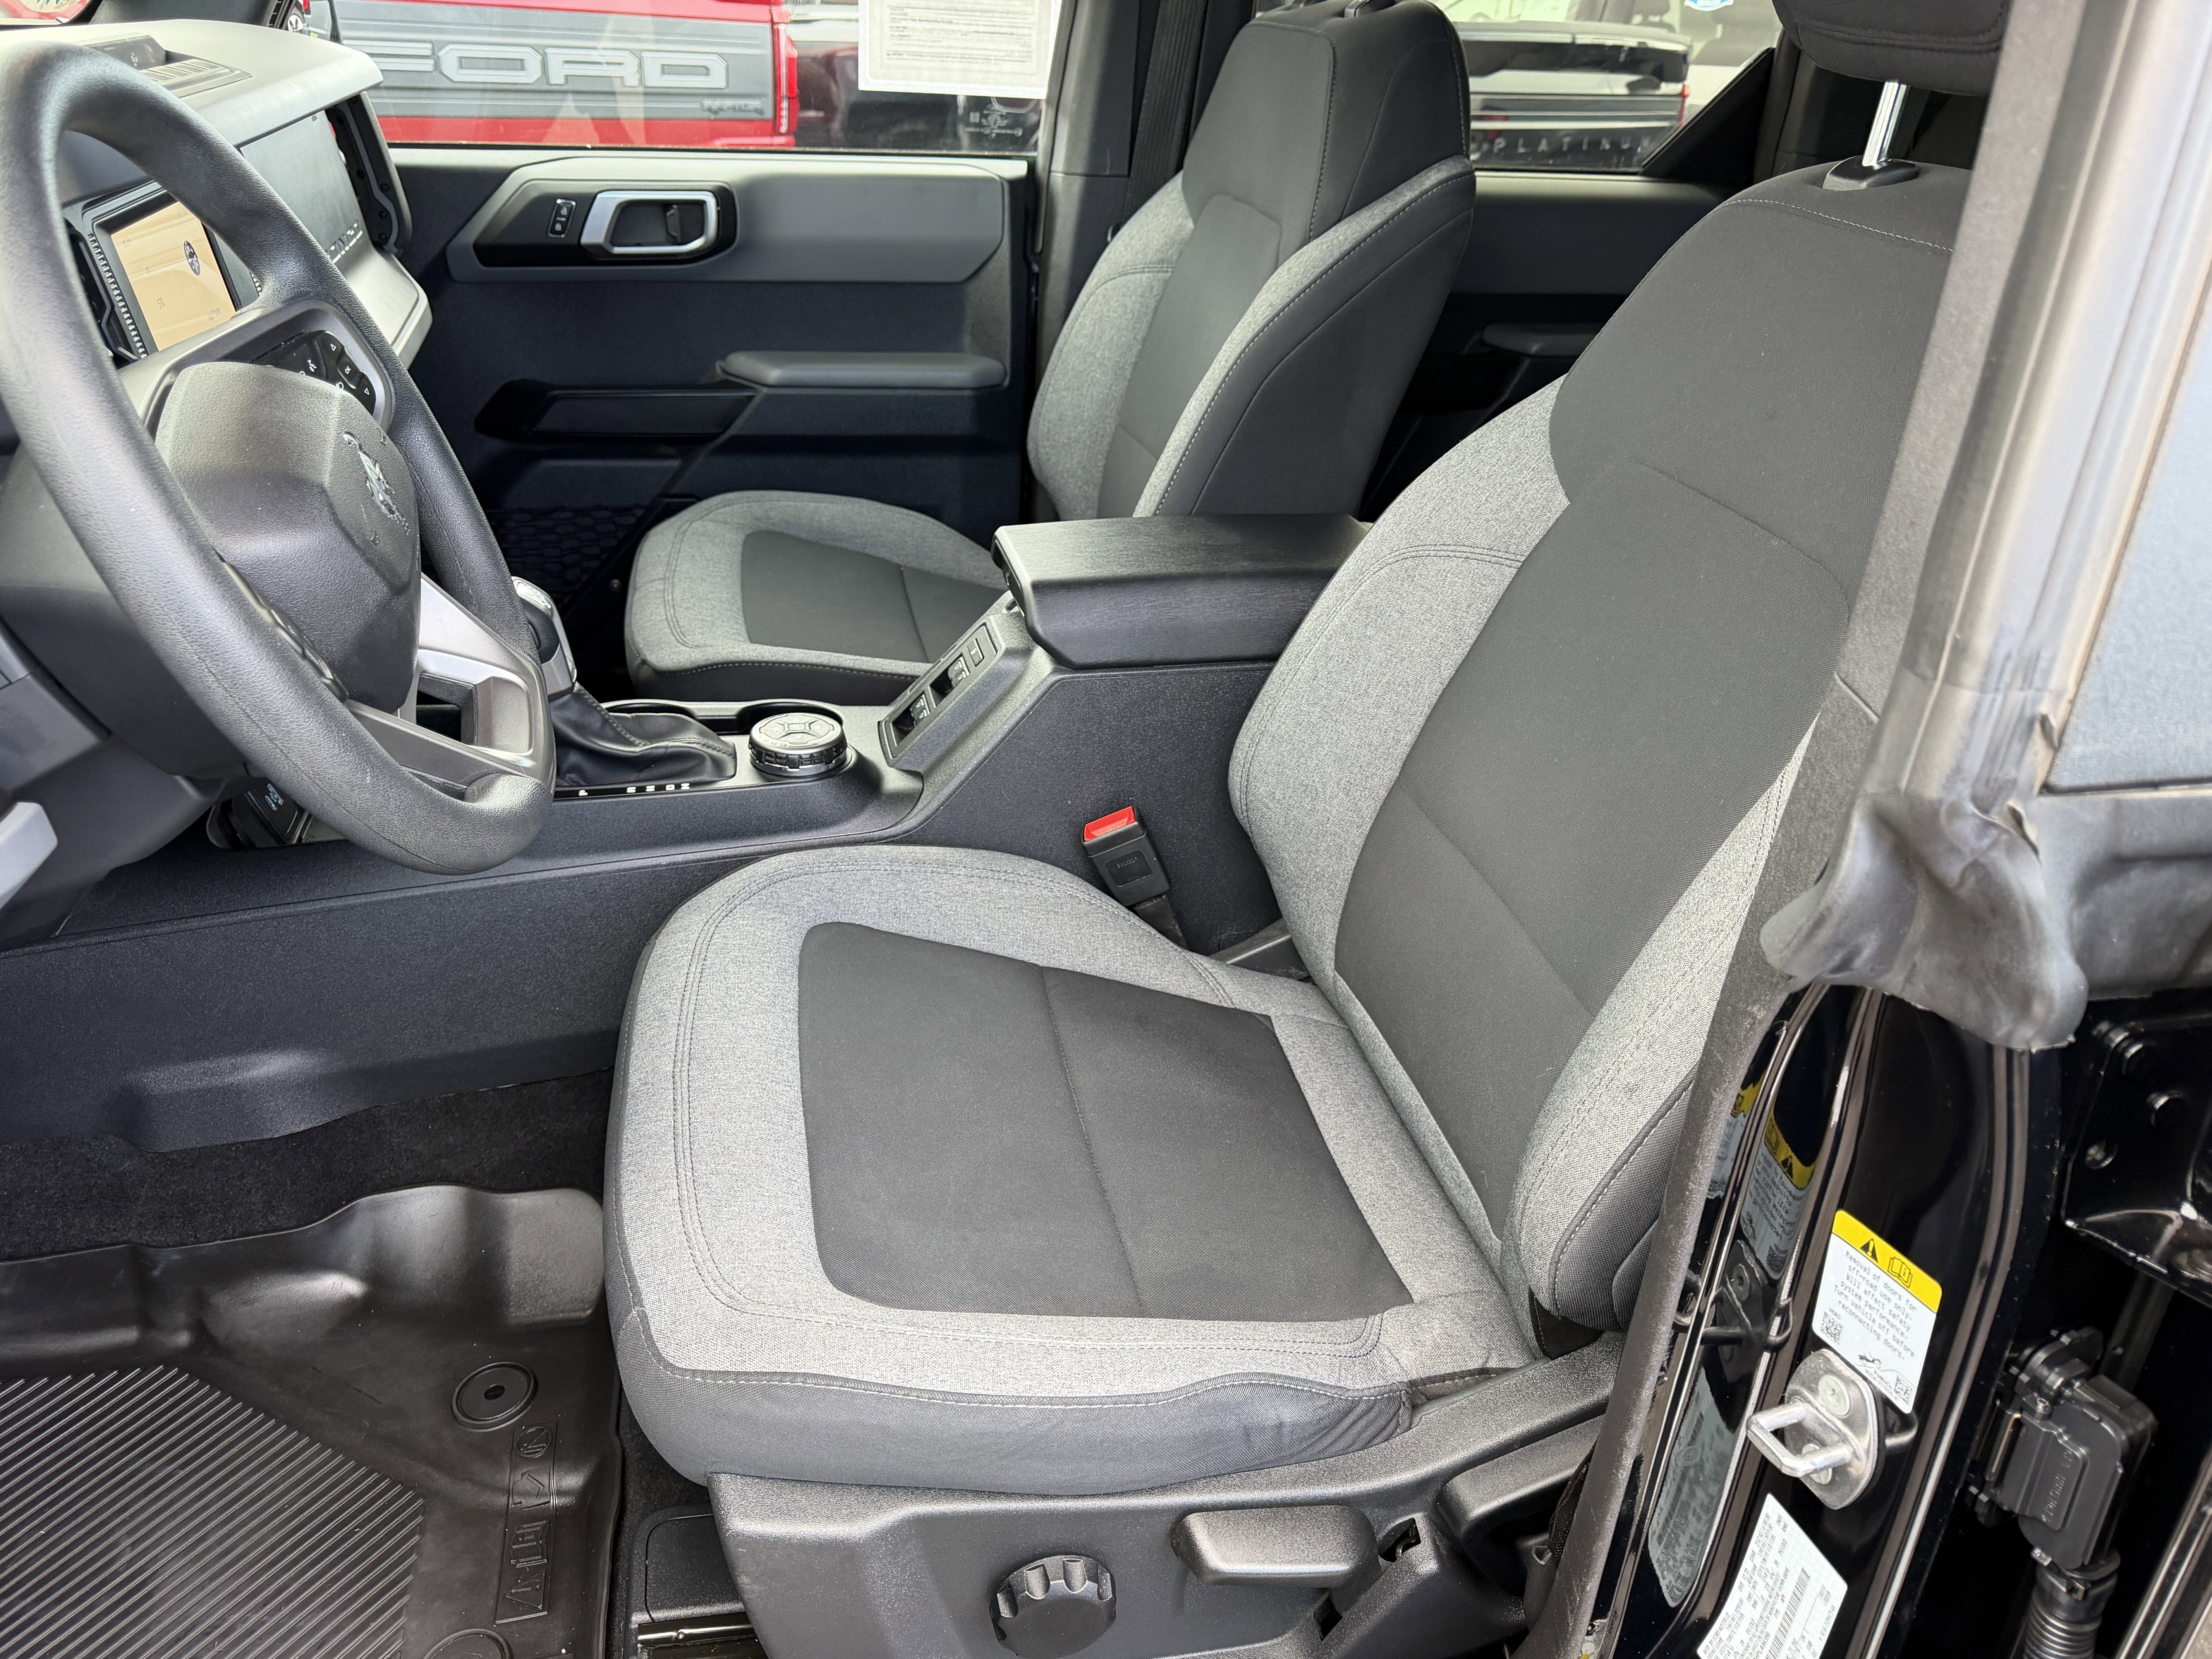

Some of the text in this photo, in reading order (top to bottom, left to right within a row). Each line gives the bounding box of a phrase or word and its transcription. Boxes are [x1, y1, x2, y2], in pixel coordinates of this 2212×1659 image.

[1840, 1281, 1862, 1301] system
[1845, 1250, 1916, 1312] Removal of doors for
[1846, 1272, 1911, 1332] Will affect safety
[1848, 1265, 1877, 1291] off-road
[1879, 1290, 1891, 1304] use
[1834, 1284, 1915, 1357] Turn vehicle off before
[1838, 1300, 1881, 1341] reconnecting
